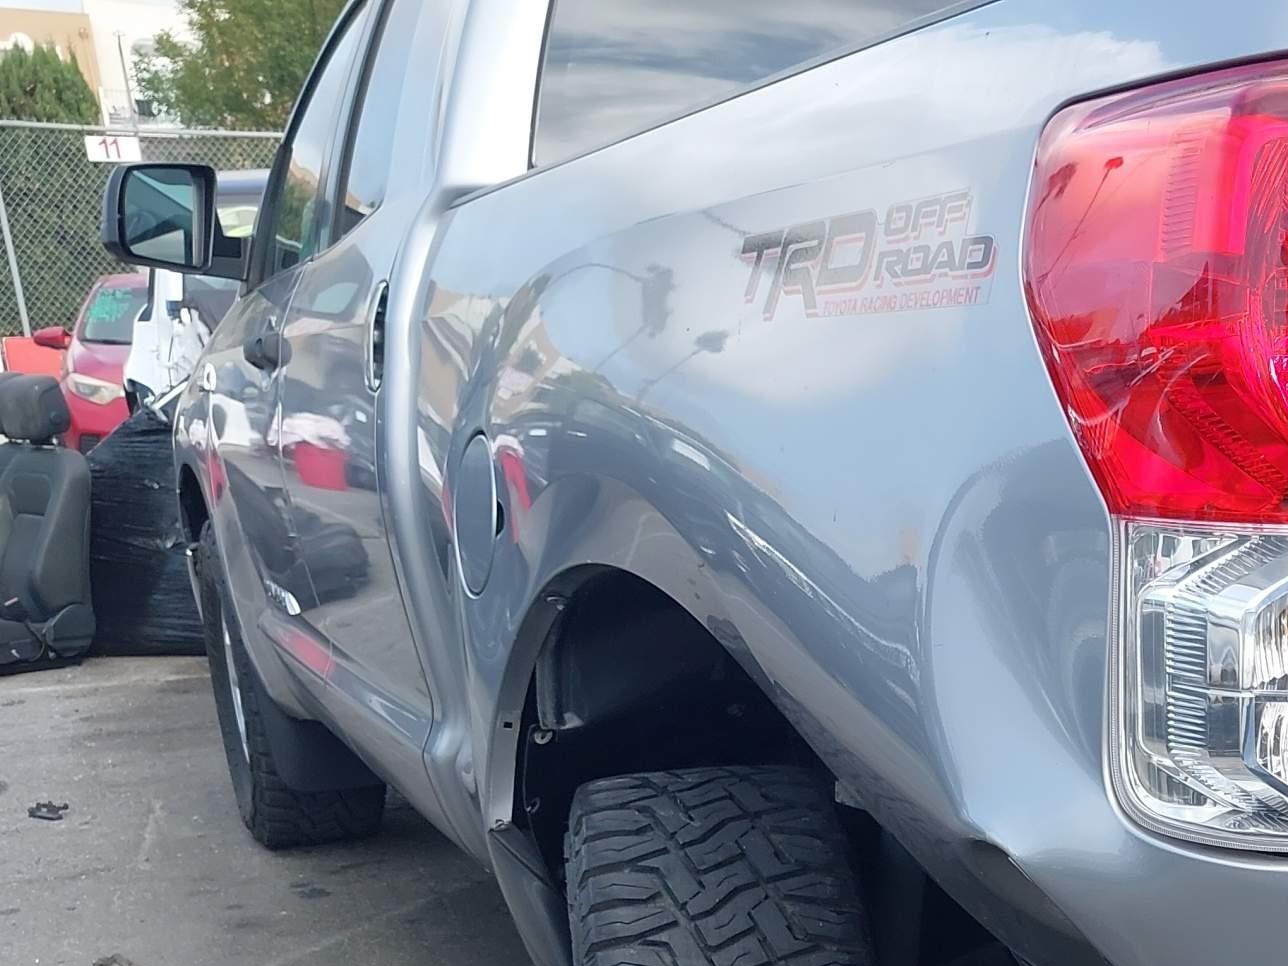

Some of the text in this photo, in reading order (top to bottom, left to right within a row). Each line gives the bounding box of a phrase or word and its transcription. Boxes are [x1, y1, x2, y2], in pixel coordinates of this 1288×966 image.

[98, 137, 121, 159] 11
[884, 193, 971, 244] OFF
[740, 207, 877, 322] TRD
[873, 235, 997, 287] ROAD
[899, 286, 981, 310] DEVELOPMENT
